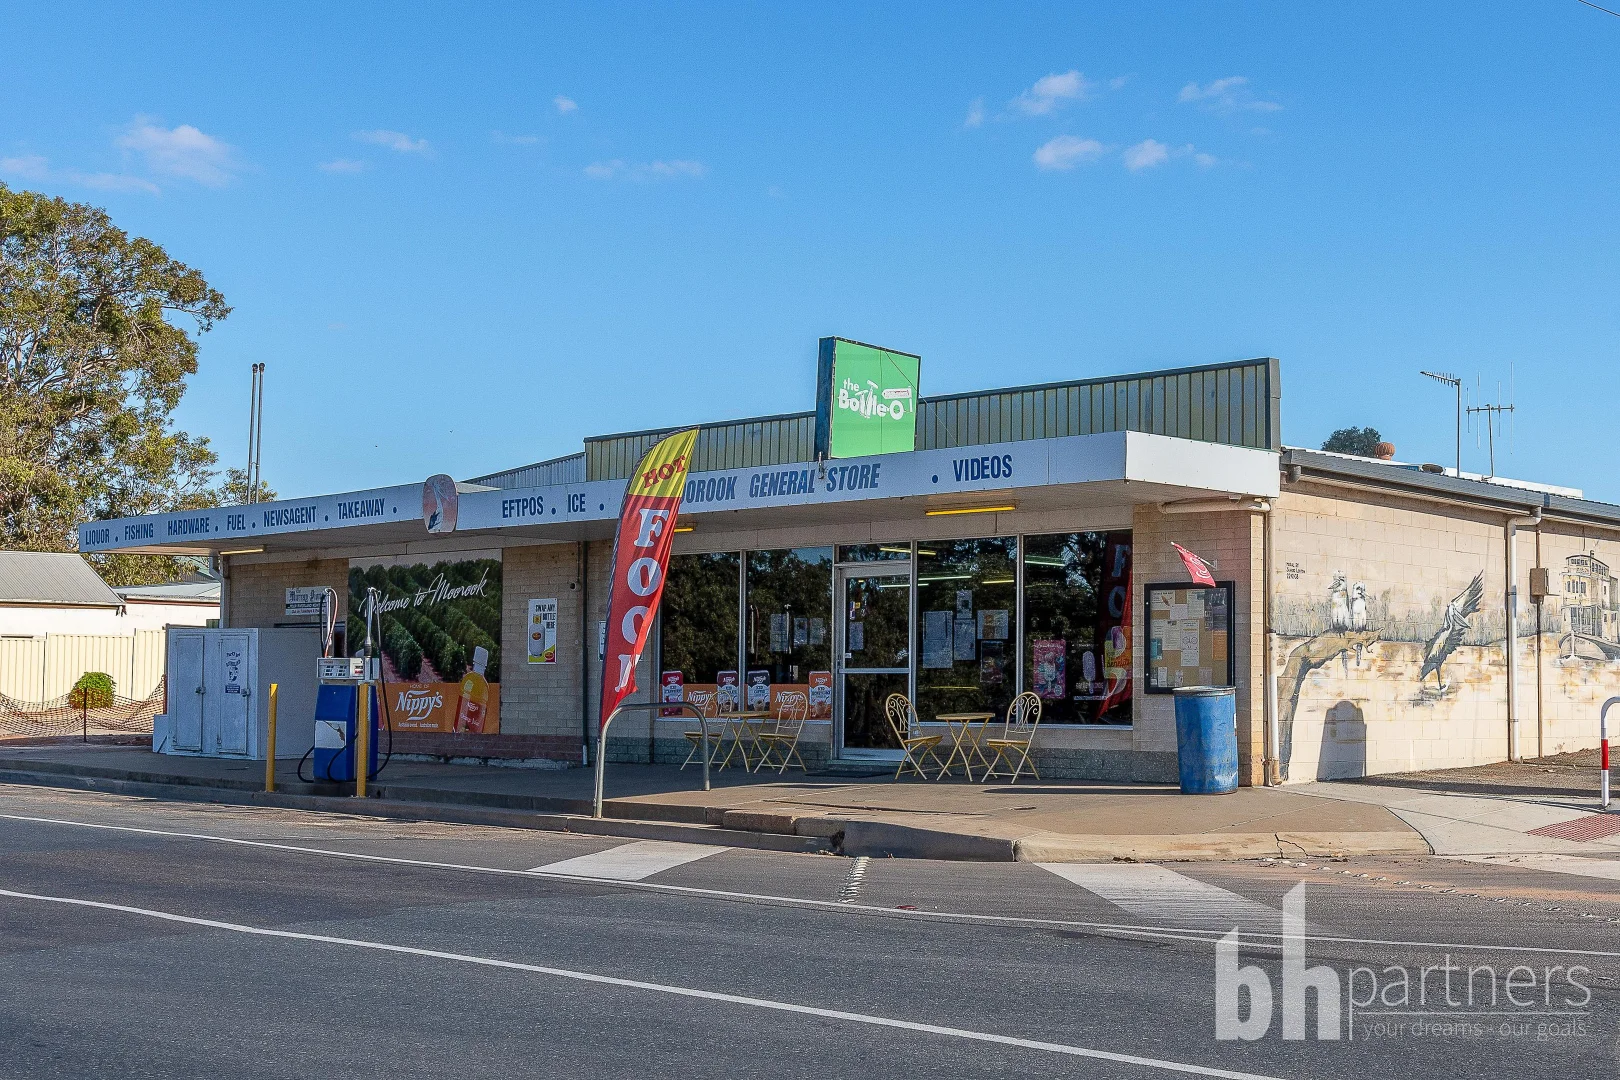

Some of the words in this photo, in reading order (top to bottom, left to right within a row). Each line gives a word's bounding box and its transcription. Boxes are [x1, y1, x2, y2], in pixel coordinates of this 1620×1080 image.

[843, 377, 860, 392] the
[641, 454, 686, 489] HOT
[680, 475, 738, 505] OROOK
[749, 468, 816, 499] GENERAL
[826, 463, 881, 492] STORE
[952, 454, 1013, 482] VIDEOS
[85, 528, 110, 545] LIQUOR
[124, 522, 154, 541] FISHING
[167, 517, 210, 536] HARDWARE
[227, 514, 246, 531] FUEL
[263, 505, 317, 528] NEWSAGENT
[337, 498, 386, 520] TAKEAWAY
[502, 495, 544, 519] EFTPOS
[567, 493, 586, 513] ICE
[414, 588, 430, 607] to
[429, 568, 489, 606] Moorook
[395, 690, 443, 721] Nippy's
